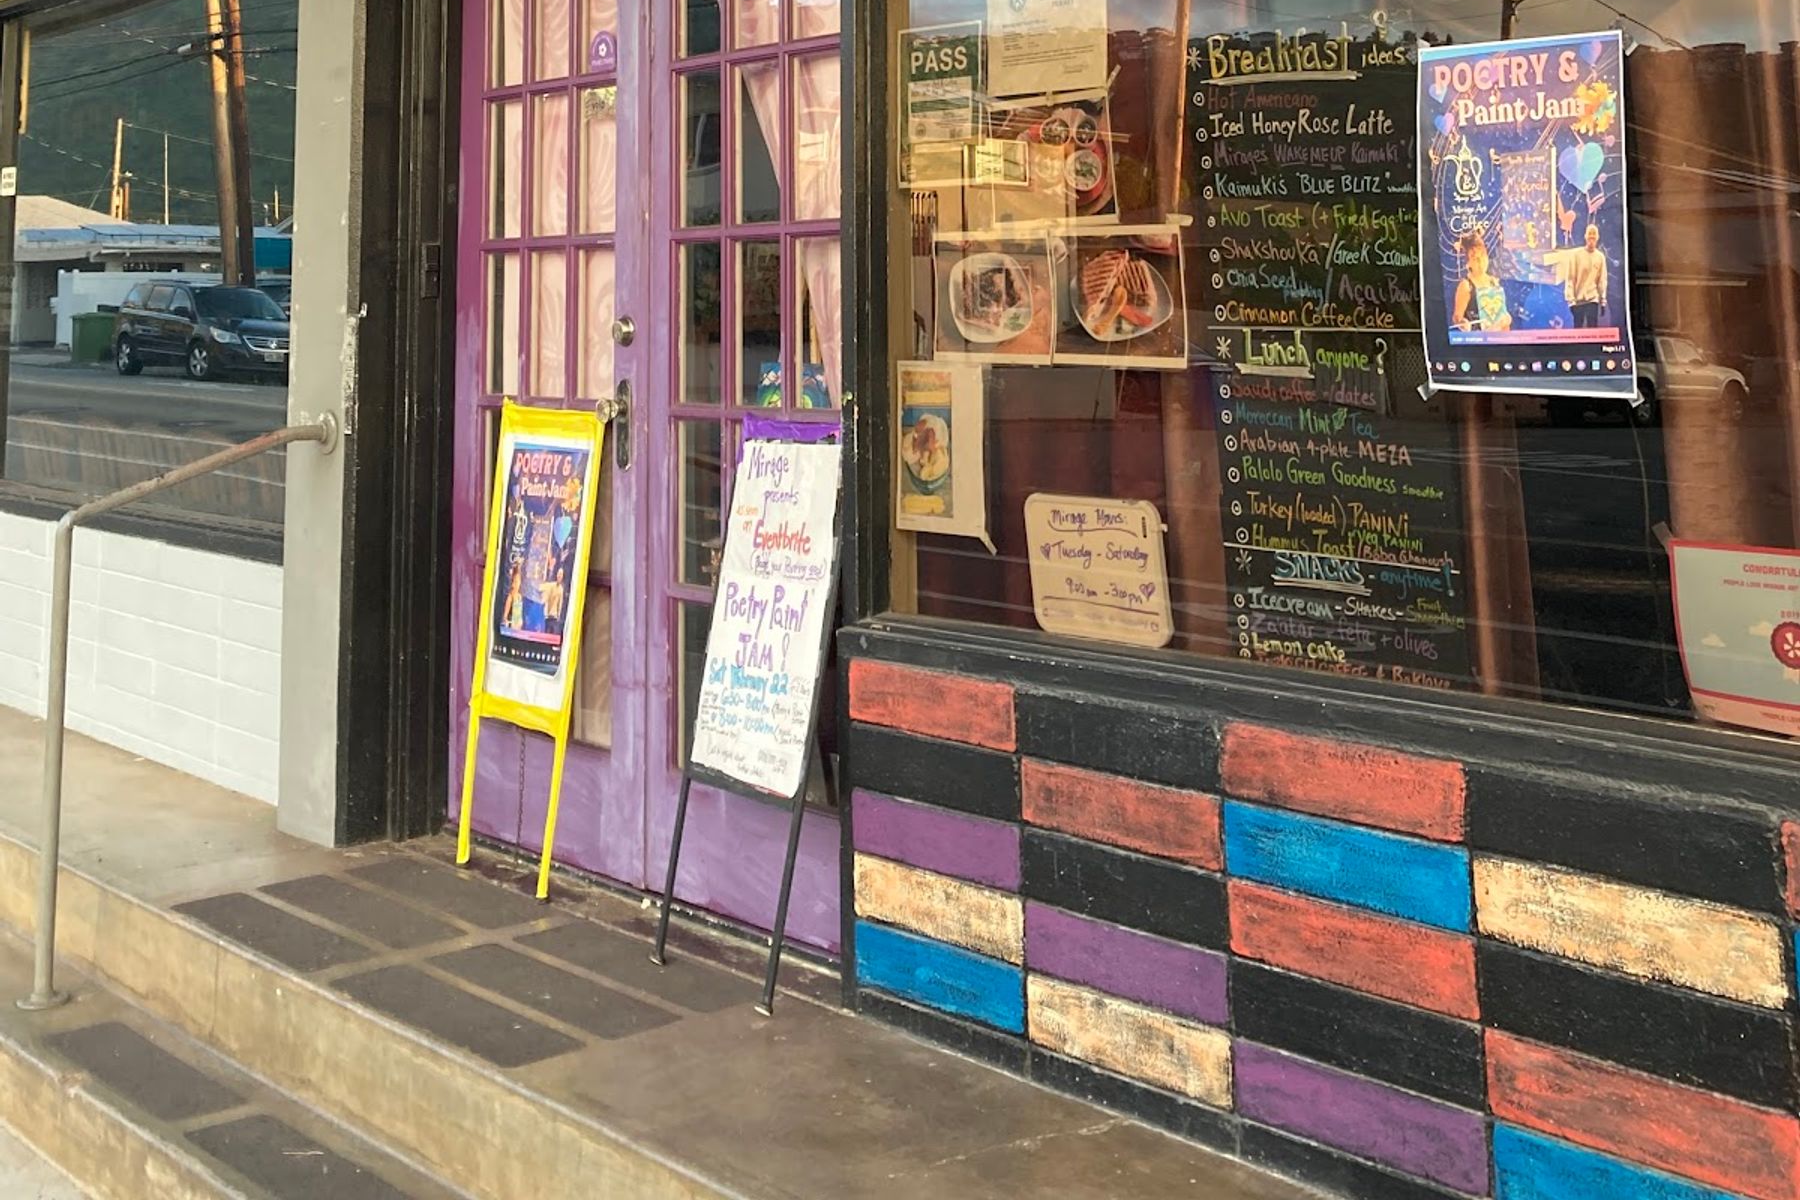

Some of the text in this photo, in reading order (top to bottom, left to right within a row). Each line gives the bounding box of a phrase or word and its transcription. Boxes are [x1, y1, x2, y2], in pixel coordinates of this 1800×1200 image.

[910, 46, 967, 75] PASS
[1207, 22, 1406, 78] Breakfast ideas
[1433, 50, 1580, 94] POETRY &
[1208, 83, 1238, 109] Hot
[1458, 95, 1524, 128] Paint
[1209, 104, 1394, 142] Iced Honey Rose Latte
[1254, 203, 1304, 228] Toast
[1225, 301, 1394, 328] Cinnamon Coffee Cake
[1316, 348, 1370, 382] anyone
[1299, 408, 1329, 434] Mint
[1350, 412, 1380, 439] Tea
[1240, 428, 1301, 457] Arabian
[1358, 439, 1412, 466] MEZA
[516, 453, 562, 476] POETRY
[748, 446, 789, 488] Mirage
[1242, 455, 1282, 482] Palolo
[1286, 457, 1326, 485] Green
[1332, 461, 1397, 494] Goodness
[521, 476, 547, 498] Paint
[1051, 509, 1087, 535] Mirage
[1247, 491, 1293, 531] Turkey
[753, 519, 811, 556] Eventbrite
[1051, 540, 1092, 569] Tuesday
[1105, 541, 1148, 571] Saturday
[1274, 550, 1365, 585] SNACKS
[1252, 631, 1303, 657] Lemon
[1394, 628, 1439, 660] olives
